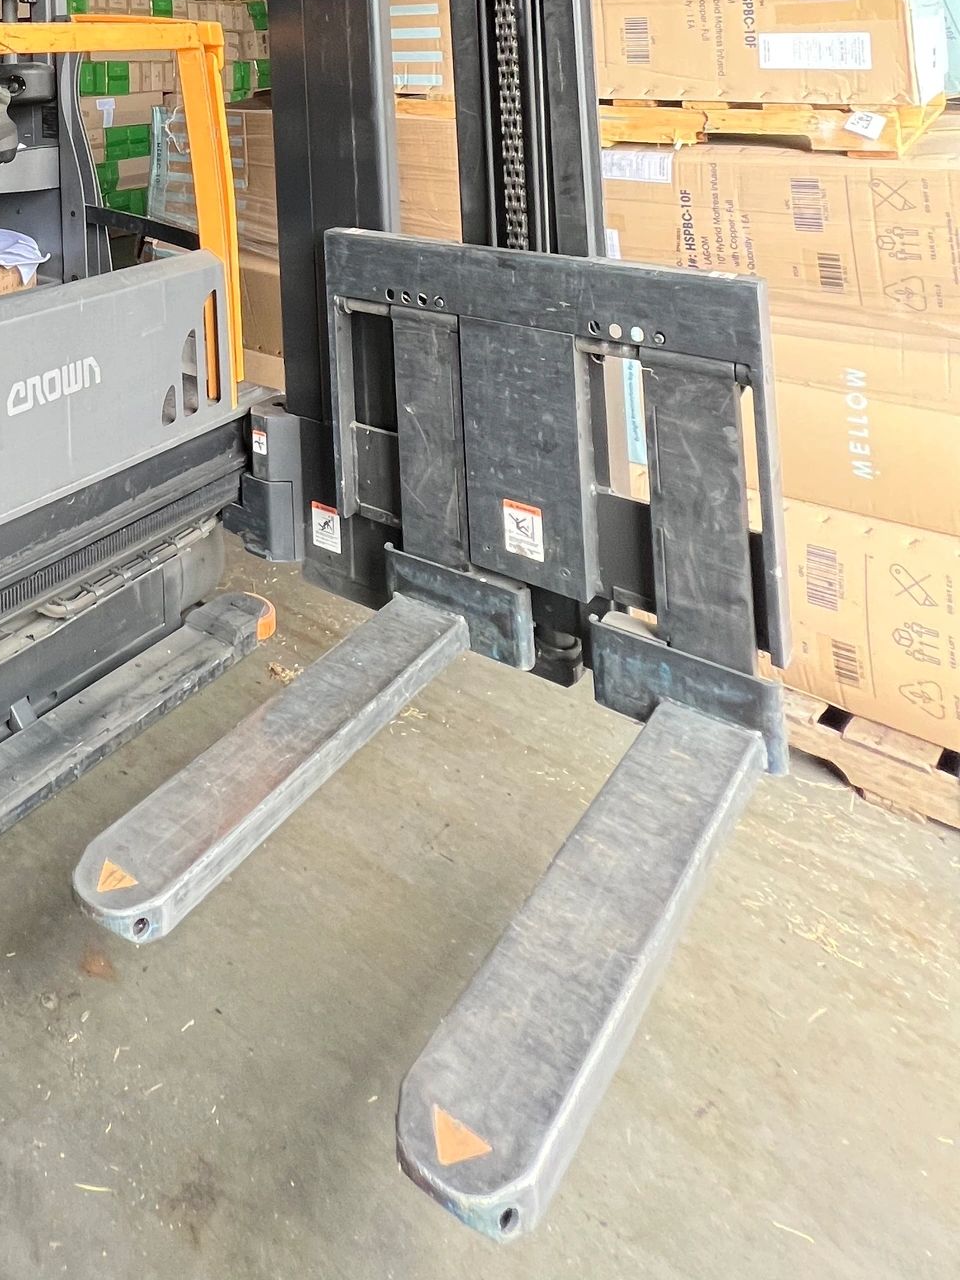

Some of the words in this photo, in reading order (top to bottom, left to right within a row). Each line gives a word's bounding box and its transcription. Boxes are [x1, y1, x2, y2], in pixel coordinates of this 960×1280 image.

[680, 190, 696, 250] HSPBC-10F
[725, 199, 734, 213] Full
[741, 214, 749, 223] EA
[714, 227, 724, 252] Hybrid
[729, 219, 738, 249] Copper
[701, 236, 712, 265] LAGOM
[6, 356, 101, 417] CROWN
[843, 367, 874, 480] MELLOW
